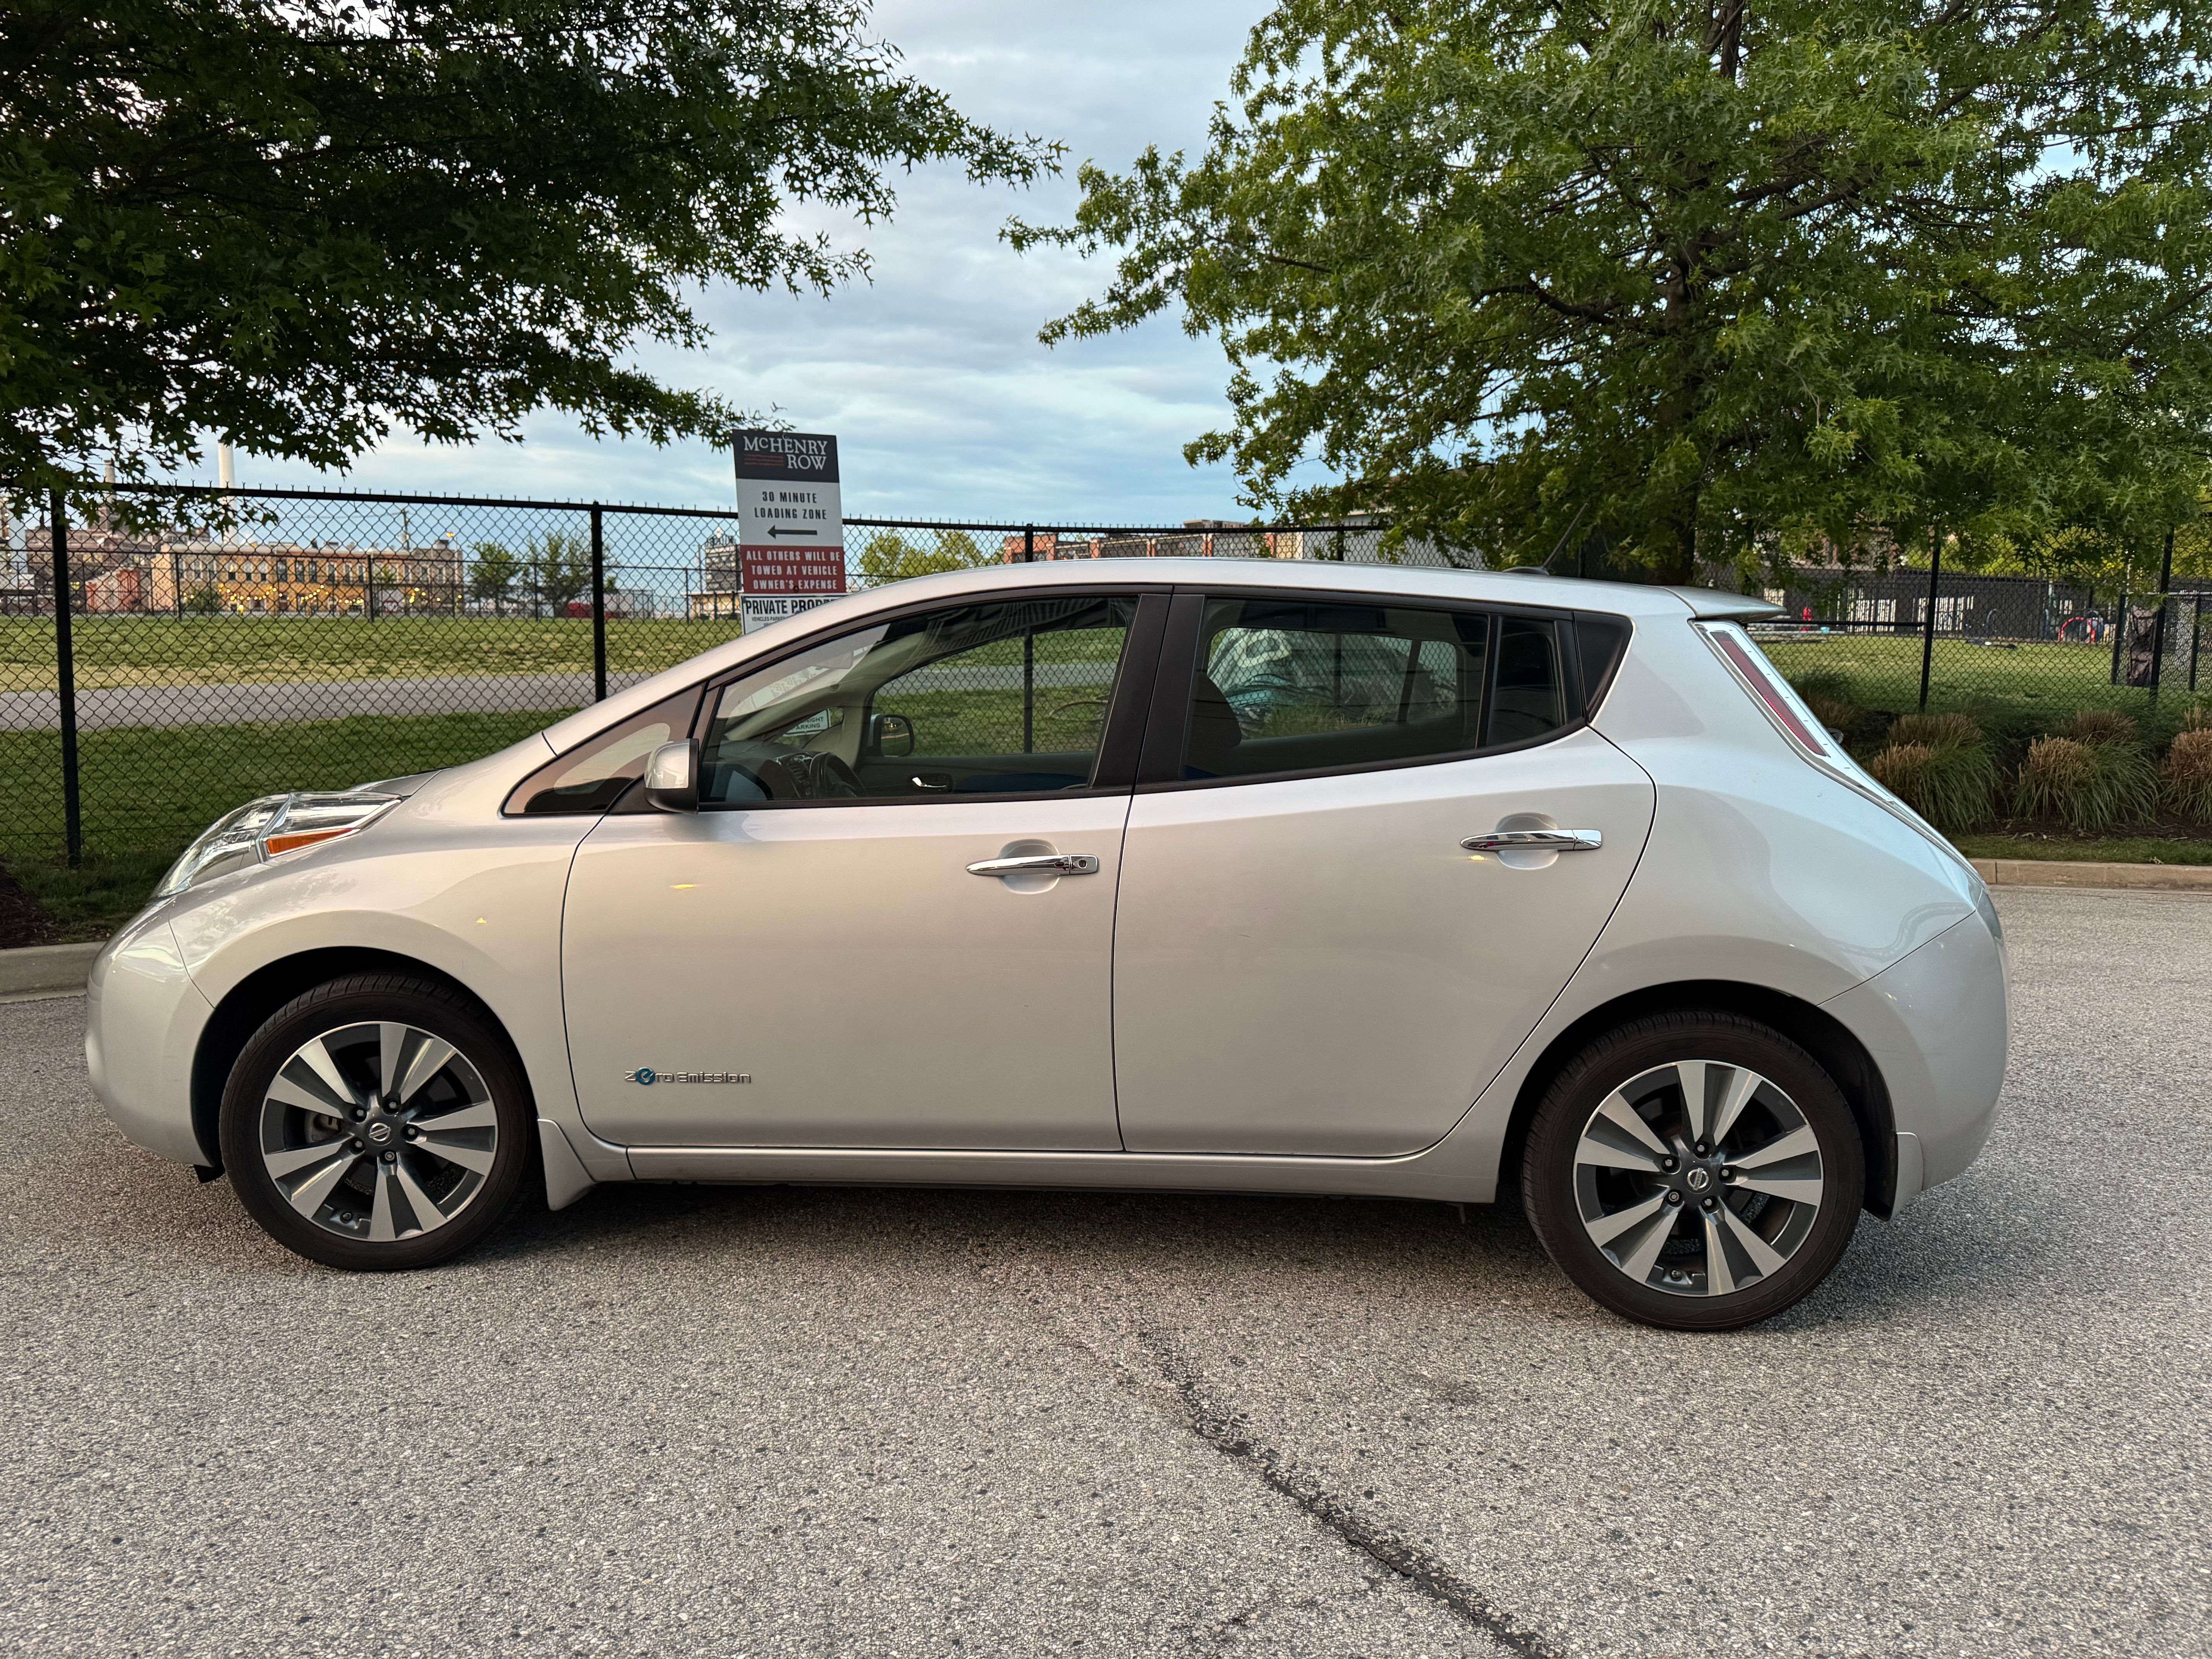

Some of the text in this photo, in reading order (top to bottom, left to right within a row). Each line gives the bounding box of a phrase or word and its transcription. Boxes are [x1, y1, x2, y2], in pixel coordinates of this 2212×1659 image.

[787, 454, 827, 470] ROW
[762, 491, 817, 503] 30 MINUTE
[754, 507, 827, 519] LOADING ZONE
[746, 551, 840, 561] ALL OTHERS WILL BE
[751, 565, 837, 575] TOWED AT VEHICLE
[753, 579, 837, 590] OWNER'S EXPENSE
[746, 600, 788, 615] PRIVATE
[677, 1071, 752, 1084] Emission
